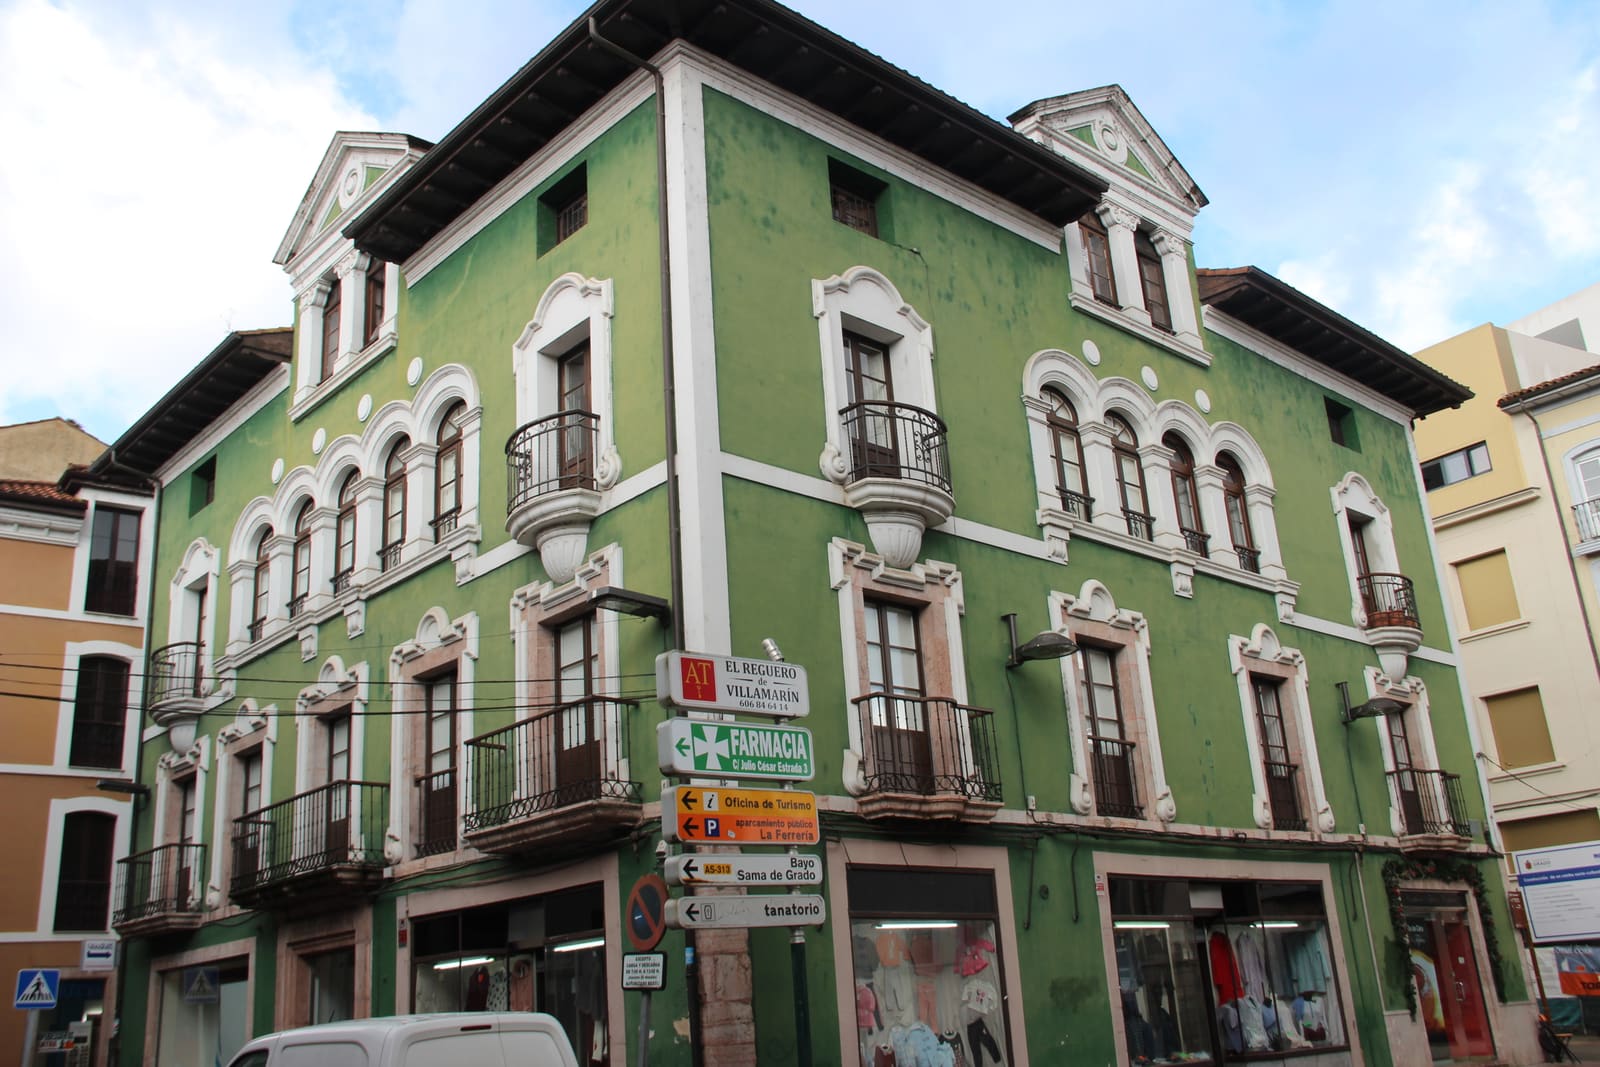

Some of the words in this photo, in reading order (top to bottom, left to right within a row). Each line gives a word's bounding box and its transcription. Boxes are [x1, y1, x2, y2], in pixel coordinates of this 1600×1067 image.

[685, 661, 711, 685] AT
[725, 660, 740, 673] EL
[742, 662, 797, 680] REGUERO
[757, 677, 768, 686] de
[726, 684, 799, 703] VILLAMARÍN
[739, 700, 756, 709] 606
[756, 701, 766, 709] 84
[767, 702, 778, 710] 64
[779, 703, 789, 711] 14
[730, 728, 808, 760] FARMACIA
[732, 759, 740, 771] C/
[741, 760, 756, 770] Julio
[757, 760, 776, 772] César
[778, 761, 802, 773] Estrada
[803, 763, 808, 773] 3
[725, 797, 759, 809] Oficina
[762, 799, 774, 809] de
[775, 799, 812, 811] Turismo
[735, 818, 785, 828] aparcamiento
[787, 820, 814, 830] público
[760, 829, 773, 840] La
[775, 830, 814, 841] Ferrería
[790, 857, 815, 869] Bayo
[704, 865, 731, 875] AS-313
[737, 870, 767, 881] Sama
[769, 869, 783, 881] de
[786, 869, 816, 881] Grado
[764, 903, 820, 917] tanatorio
